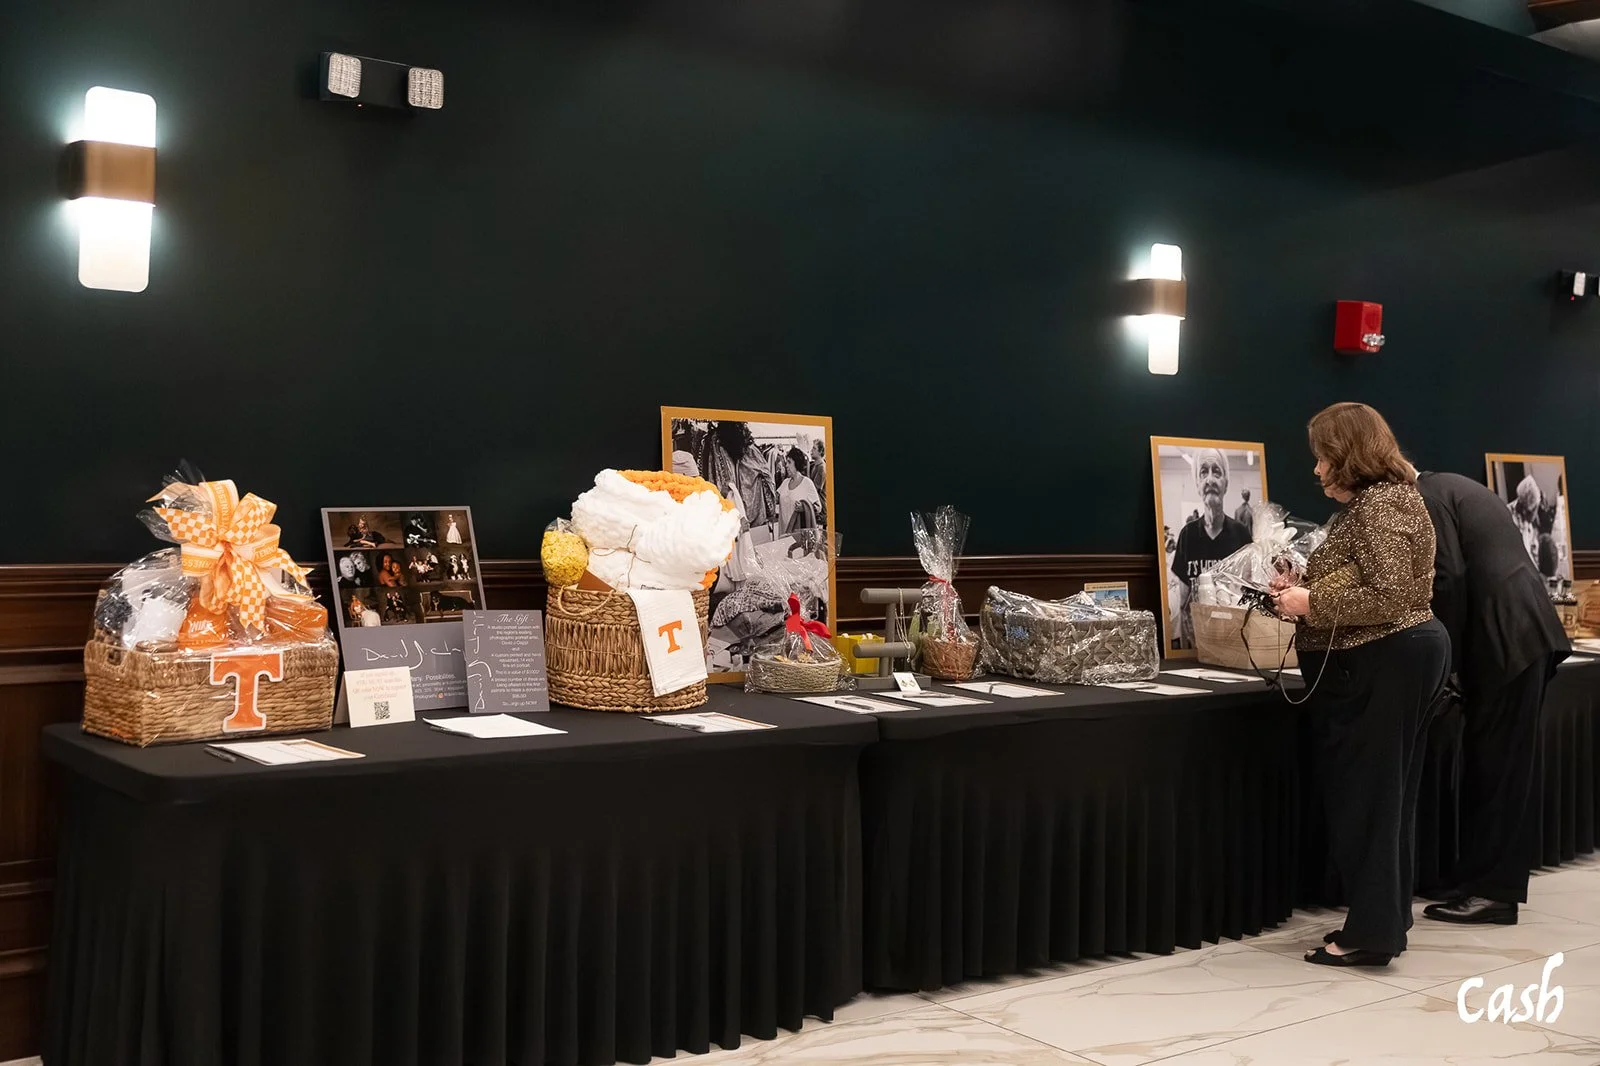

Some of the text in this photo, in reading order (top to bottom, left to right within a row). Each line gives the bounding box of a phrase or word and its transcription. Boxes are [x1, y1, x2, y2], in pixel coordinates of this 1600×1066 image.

[496, 613, 529, 626] The Gift
[658, 619, 682, 654] T
[209, 649, 284, 733] T
